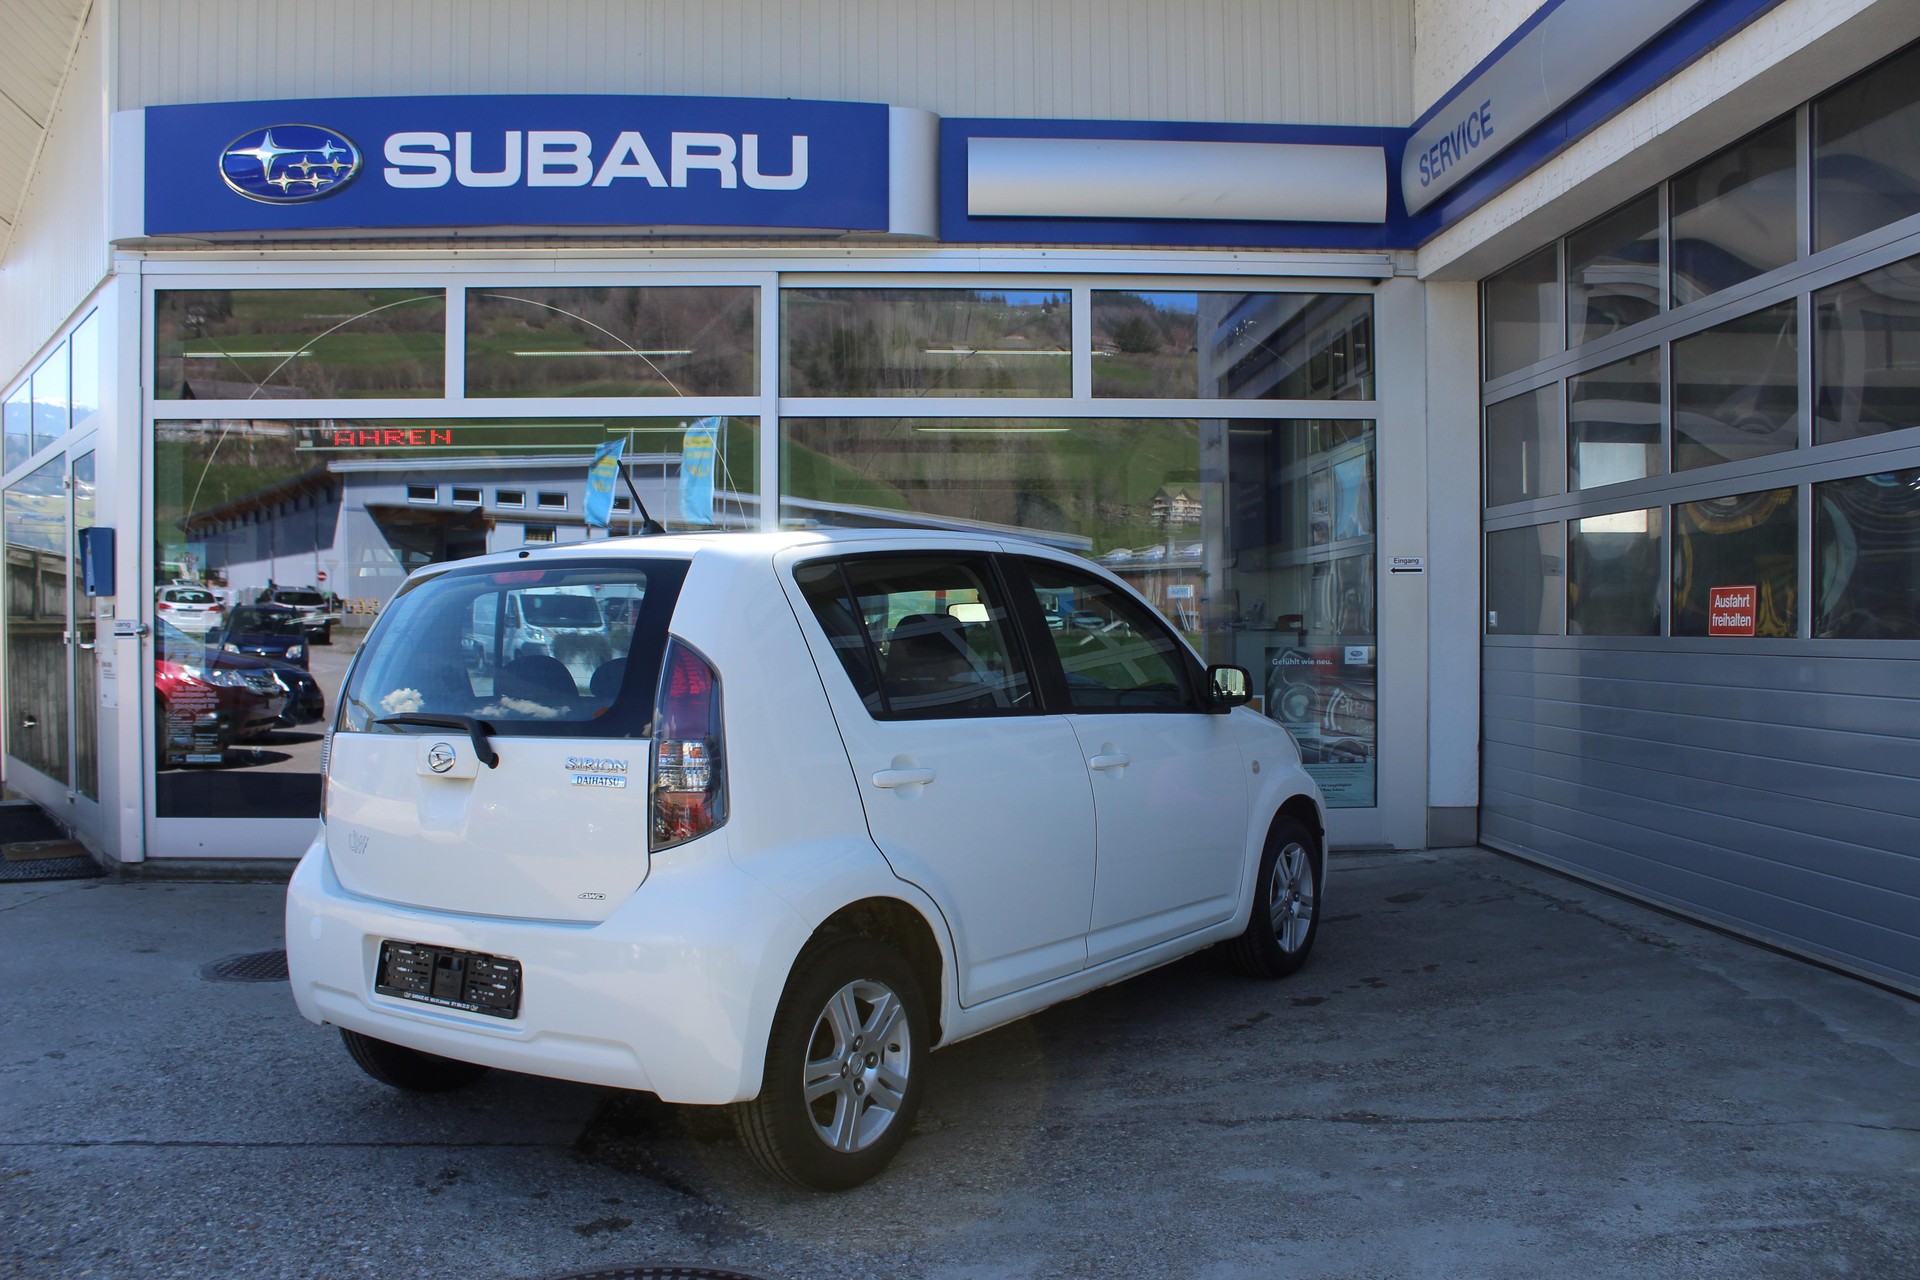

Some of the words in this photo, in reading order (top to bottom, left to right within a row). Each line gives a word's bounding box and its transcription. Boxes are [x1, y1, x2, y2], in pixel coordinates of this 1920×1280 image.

[1419, 99, 1494, 187] SERVICE
[383, 130, 808, 190] SUBARU
[334, 429, 451, 445] AHREN
[1393, 557, 1420, 565] Eingang
[1714, 594, 1751, 608] Ausfahrt
[1712, 613, 1752, 627] freihalten
[1272, 657, 1300, 665] Gefühlt
[565, 756, 629, 774] SIRION
[576, 775, 620, 787] DAIHATSU
